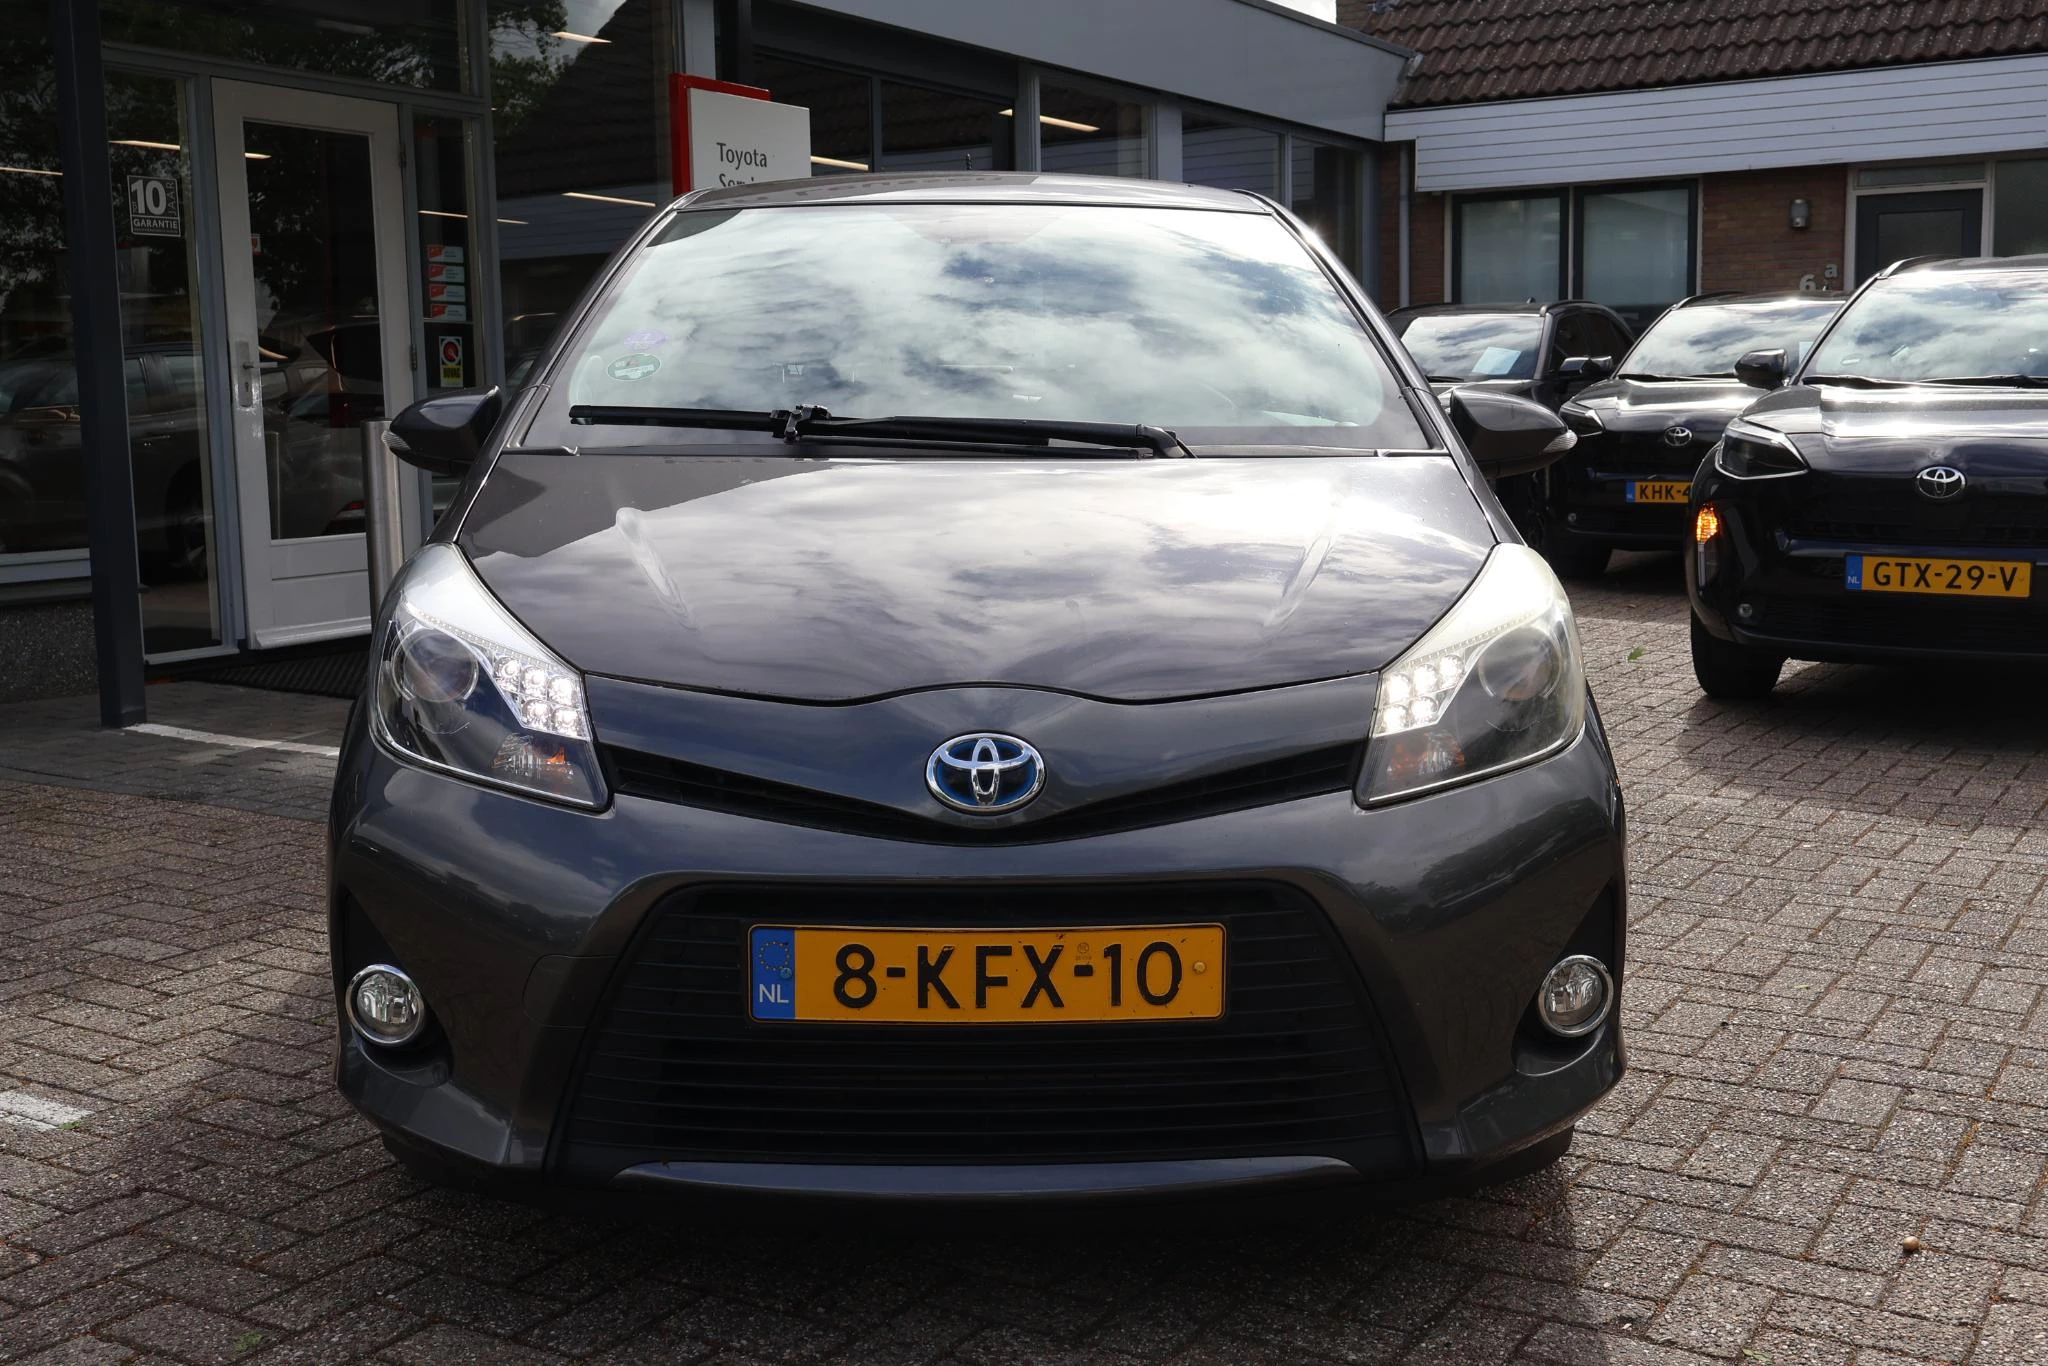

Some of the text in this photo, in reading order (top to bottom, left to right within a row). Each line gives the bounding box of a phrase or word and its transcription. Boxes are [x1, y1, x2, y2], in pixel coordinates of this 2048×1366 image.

[716, 142, 768, 170] Toyota
[131, 180, 167, 215] 10
[166, 182, 177, 216] JAAR
[133, 218, 178, 229] GARANTIE
[1847, 561, 2018, 592] NL GTX-29-V
[758, 983, 789, 1004] NL
[832, 941, 1183, 1009] 8-KFX-10
